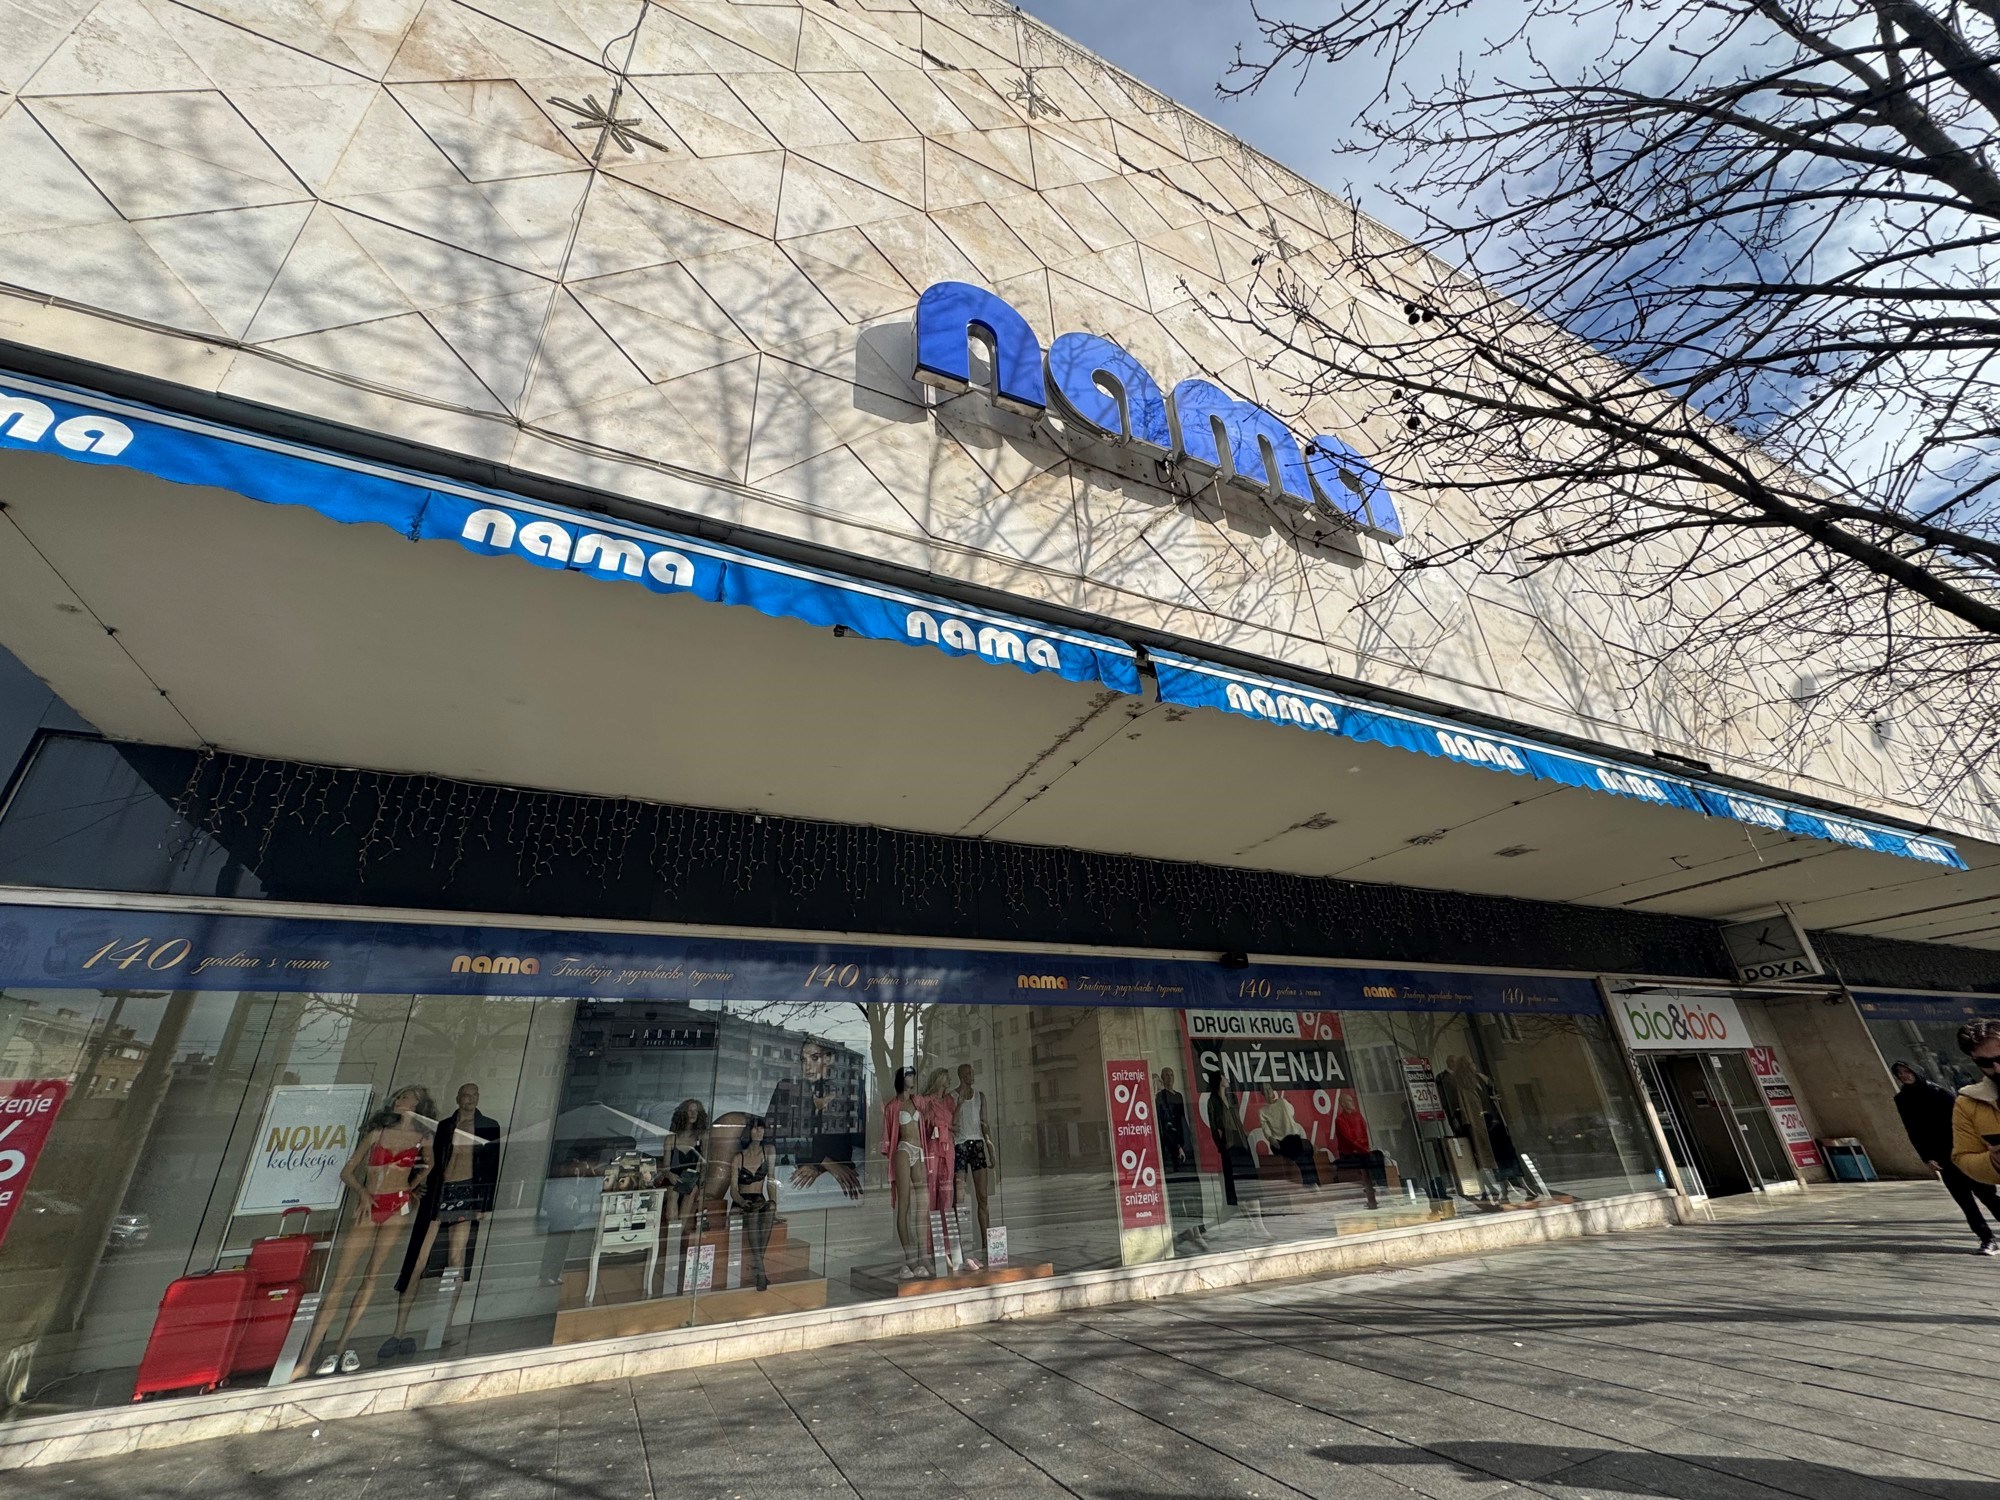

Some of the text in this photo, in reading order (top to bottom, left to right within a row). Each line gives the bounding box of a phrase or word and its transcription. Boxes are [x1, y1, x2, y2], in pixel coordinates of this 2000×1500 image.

[914, 280, 1403, 541] nama
[462, 508, 695, 587] nama
[906, 611, 1061, 669] nama
[1226, 683, 1339, 730] nama
[1436, 730, 1525, 769] nama
[1596, 767, 1669, 800] nama
[1728, 798, 1786, 827] nama
[82, 937, 333, 974] 140 godina s vama
[451, 955, 540, 975] nama
[550, 957, 735, 986] Tradicija zagrebačke trgovine
[804, 963, 859, 988] 140
[864, 970, 900, 991] godina
[1017, 974, 1069, 990] nama
[1743, 960, 1808, 981] DOXA
[1239, 978, 1271, 998] 140
[1363, 986, 1397, 998] nama
[1502, 987, 1524, 1004] 140
[630, 1029, 701, 1038] JADRAN
[1193, 1016, 1295, 1034] DRUGI KRUG
[1623, 1002, 1726, 1040] bio&bio
[1112, 1069, 1145, 1083] sniženje
[1200, 1043, 1345, 1083] SNIŽENJA
[266, 1124, 347, 1152] NOVA
[1117, 1122, 1152, 1136] sniženje
[267, 1141, 338, 1182] kolekcija
[1125, 1192, 1159, 1206] sniženje
